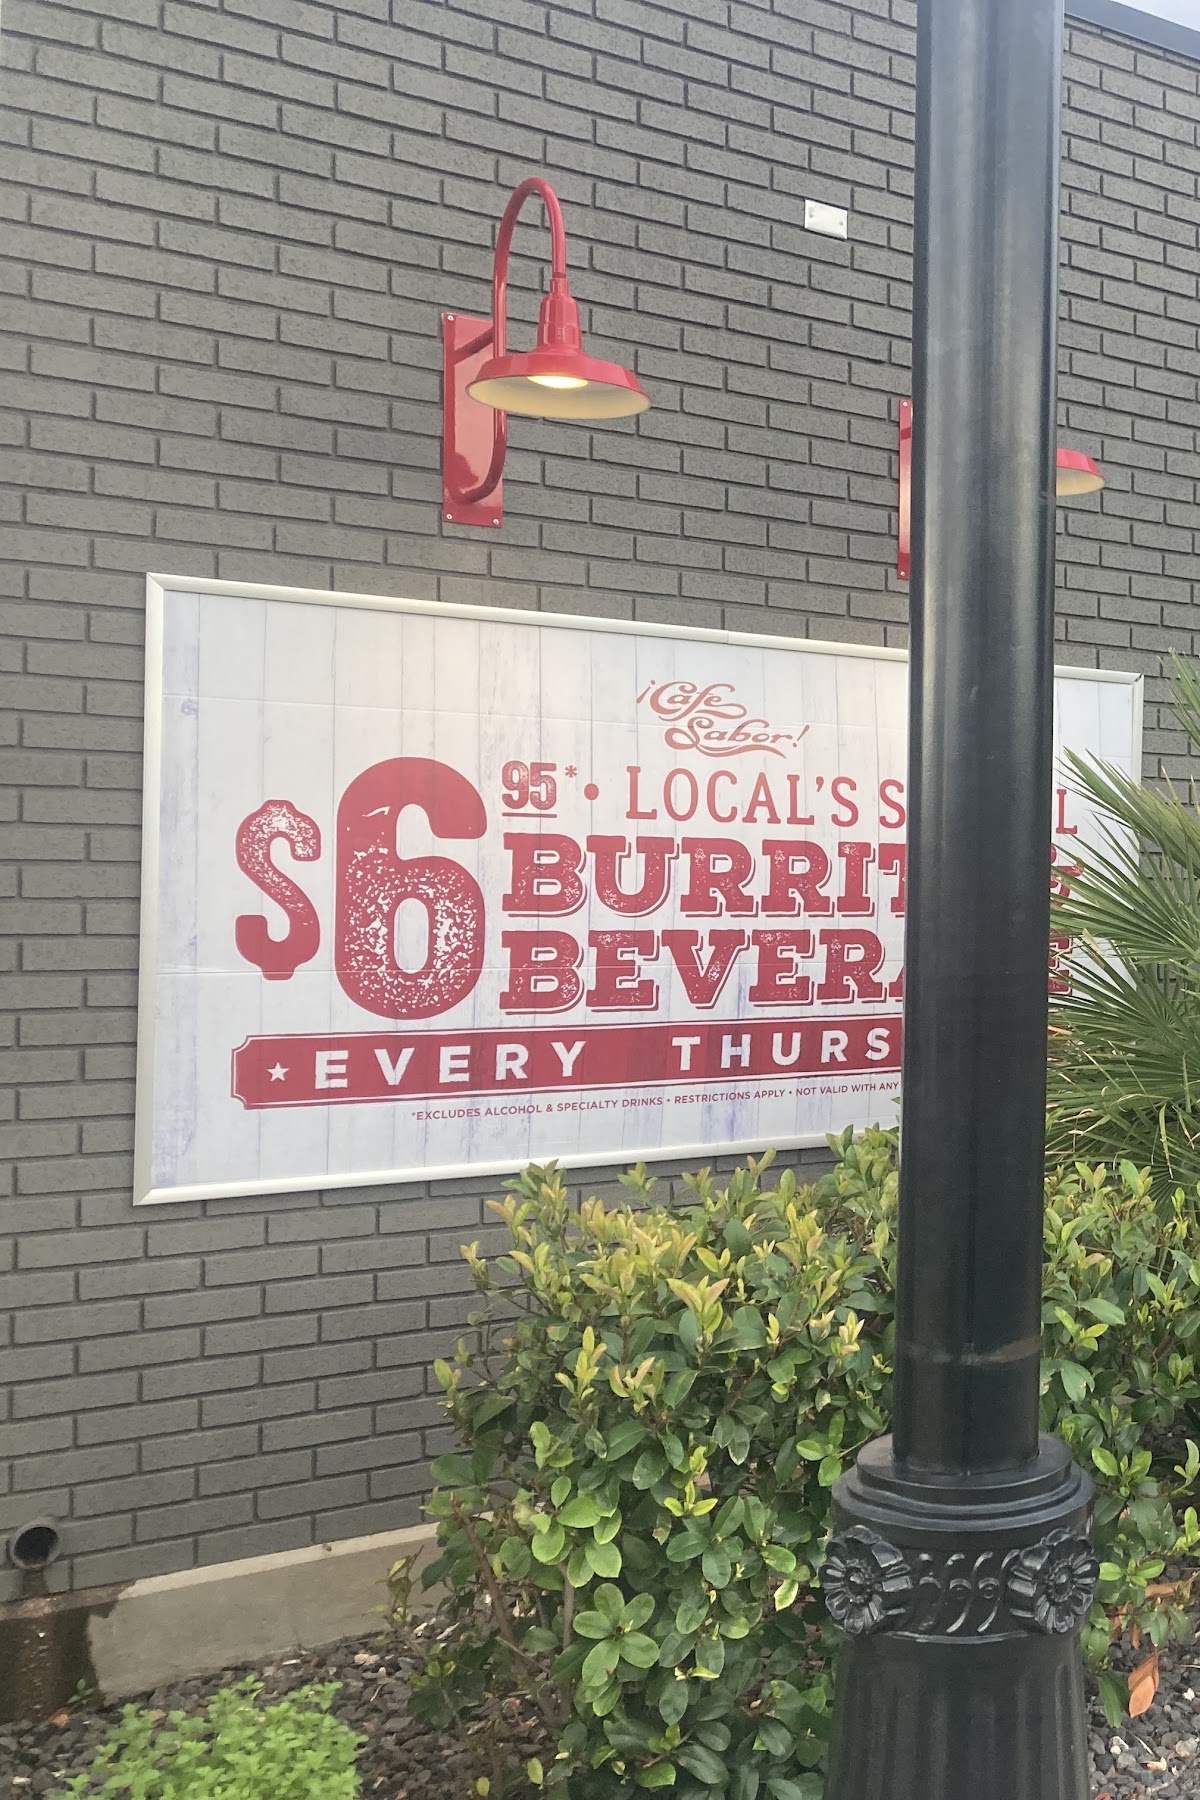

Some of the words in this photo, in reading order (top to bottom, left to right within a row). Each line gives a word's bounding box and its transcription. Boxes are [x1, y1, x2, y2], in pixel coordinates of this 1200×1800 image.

[664, 716, 810, 760] Sabor!
[626, 765, 859, 828] LOCAL'S
[501, 832, 905, 918] BURRI
[499, 928, 904, 1015] BEVER
[315, 1040, 587, 1090] EVERY
[672, 1027, 891, 1071] THURS
[485, 1104, 542, 1116] ALCOHOL
[546, 1103, 553, 1113] &
[557, 1099, 618, 1112] SPECIALTY
[622, 1096, 663, 1108] DRINKS
[674, 1091, 751, 1104] RESTRICTIONS
[754, 1089, 786, 1099] APPLY
[796, 1086, 817, 1096] NOT
[820, 1085, 848, 1095] VALID
[851, 1083, 876, 1093] WITH
[879, 1081, 900, 1091] ANY
